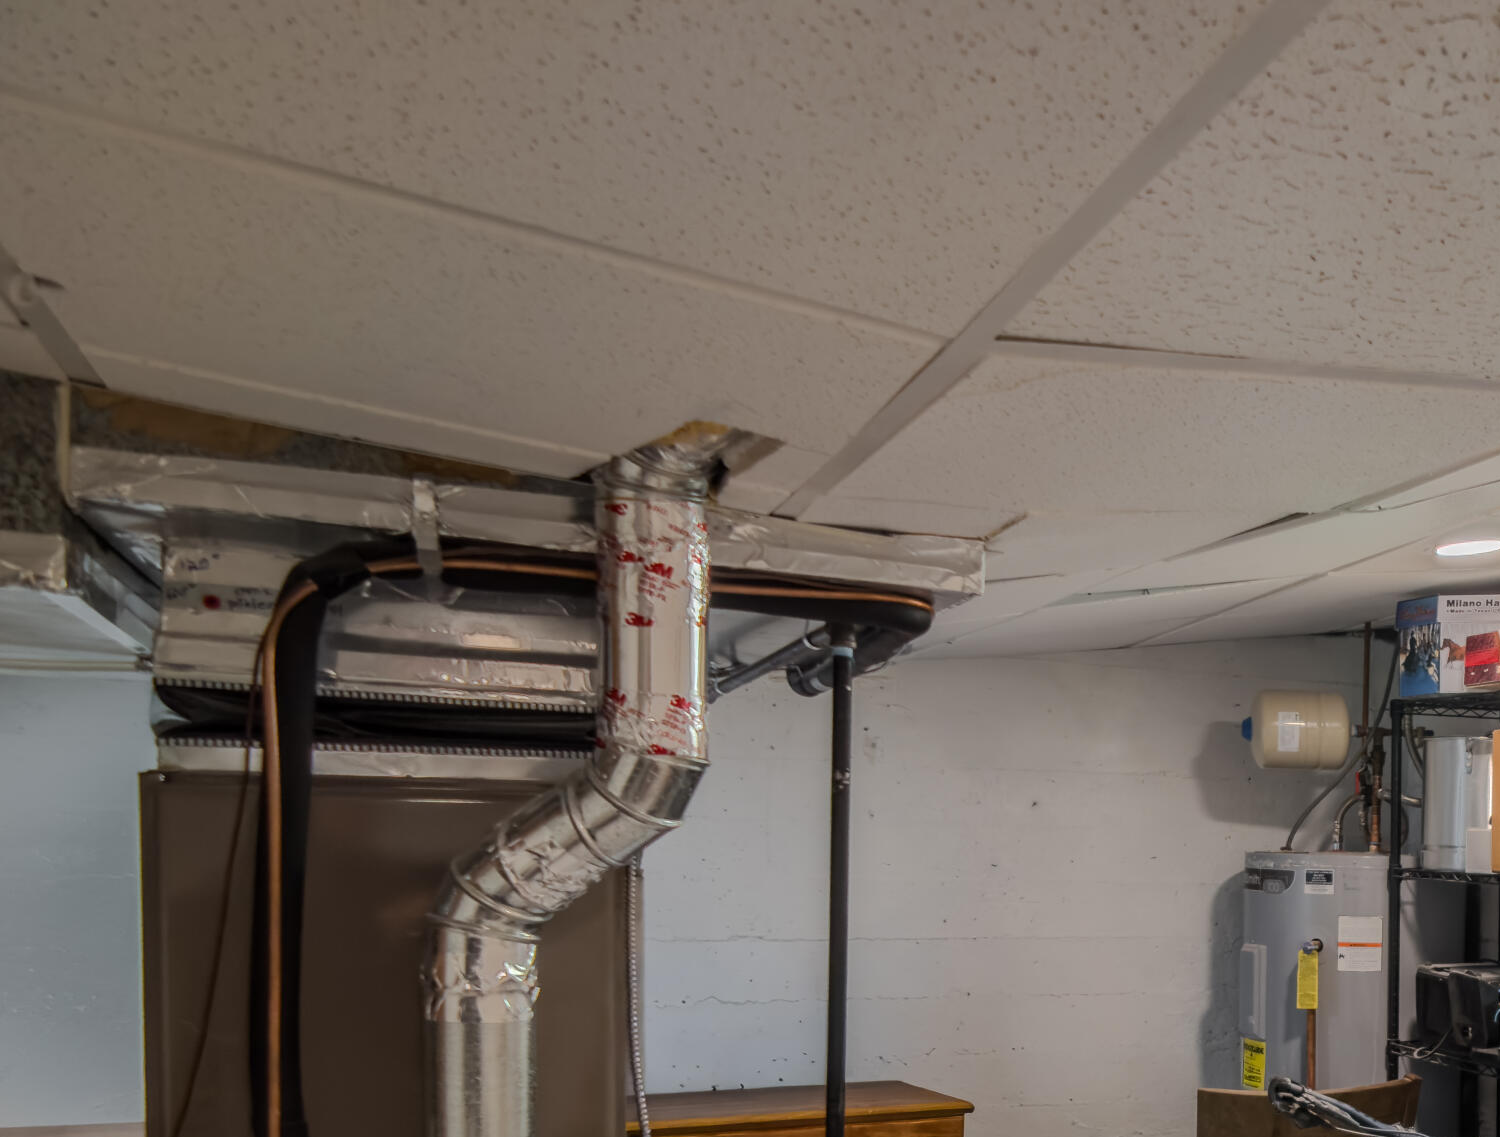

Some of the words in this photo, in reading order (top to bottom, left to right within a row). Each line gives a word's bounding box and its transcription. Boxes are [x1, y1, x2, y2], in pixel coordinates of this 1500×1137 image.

[643, 563, 674, 579] 3M
[1446, 599, 1482, 608] Milano
[624, 612, 653, 627] 3M
